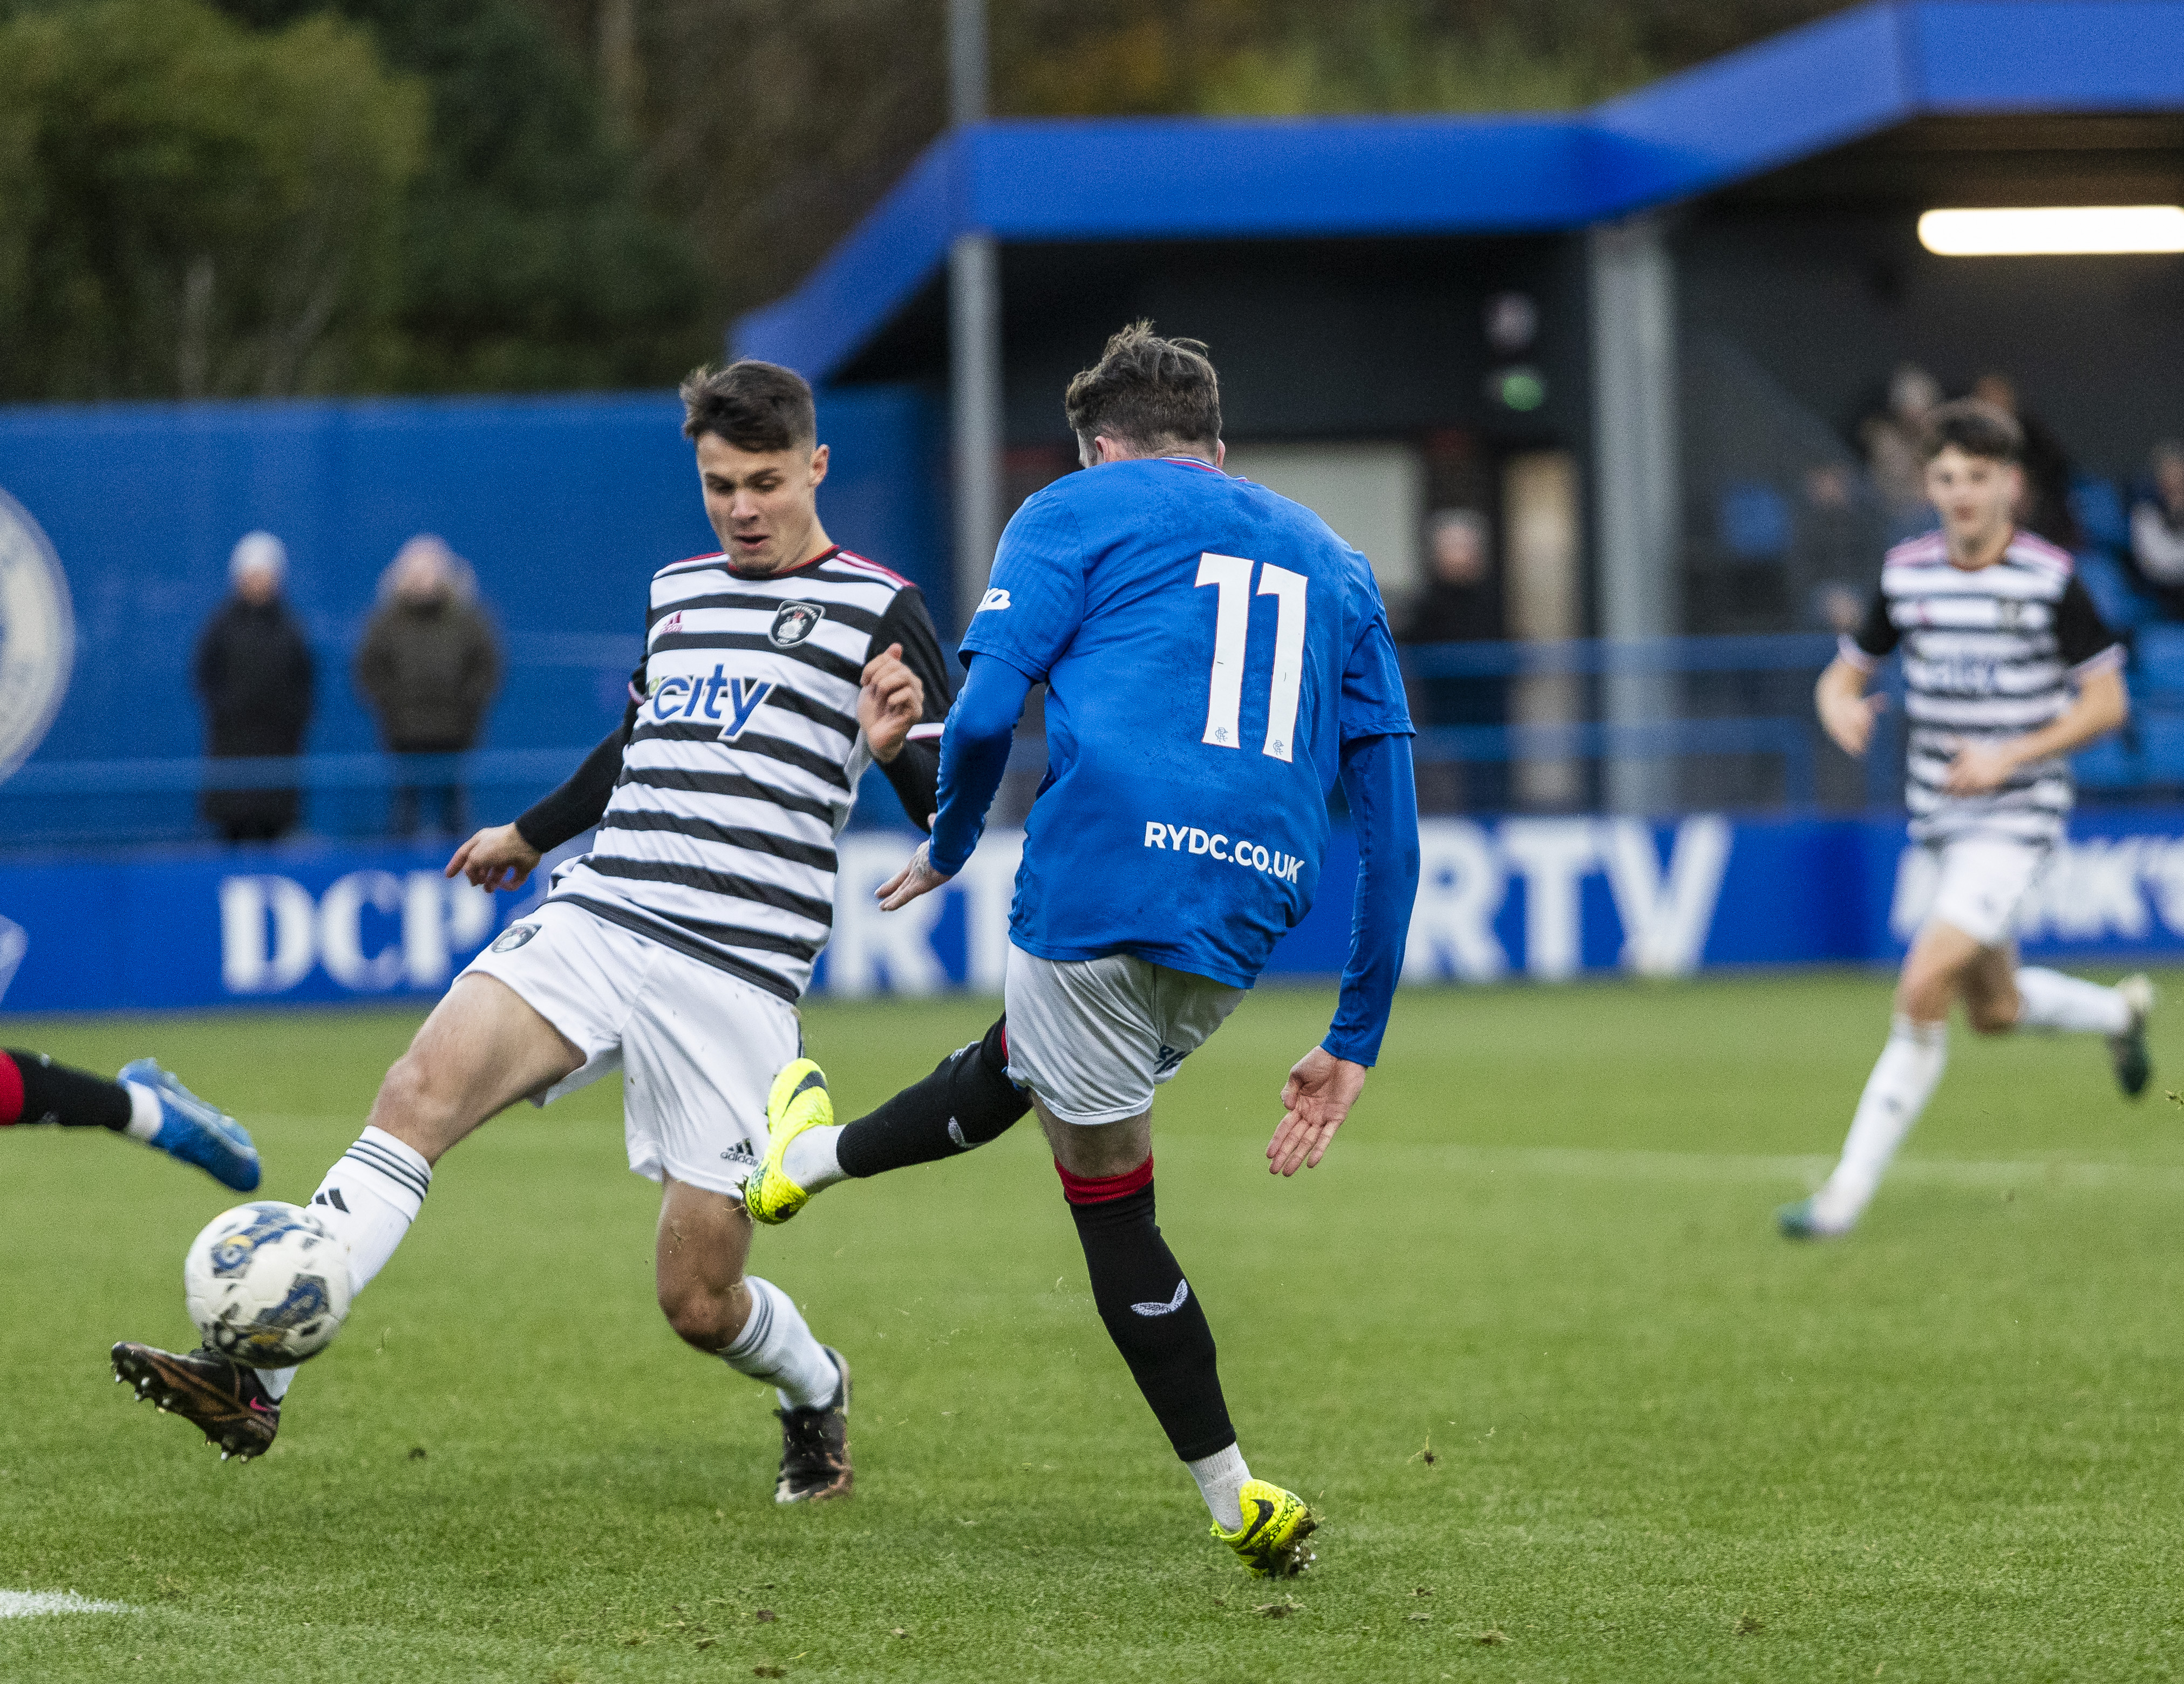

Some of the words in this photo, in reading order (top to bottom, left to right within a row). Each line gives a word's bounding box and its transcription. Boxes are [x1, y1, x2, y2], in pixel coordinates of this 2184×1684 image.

[653, 663, 773, 736] city
[1193, 552, 1309, 763] 11
[1144, 821, 1305, 884] RYDC.CO.UK
[1401, 815, 1730, 982] RTV
[219, 870, 496, 994] DCP
